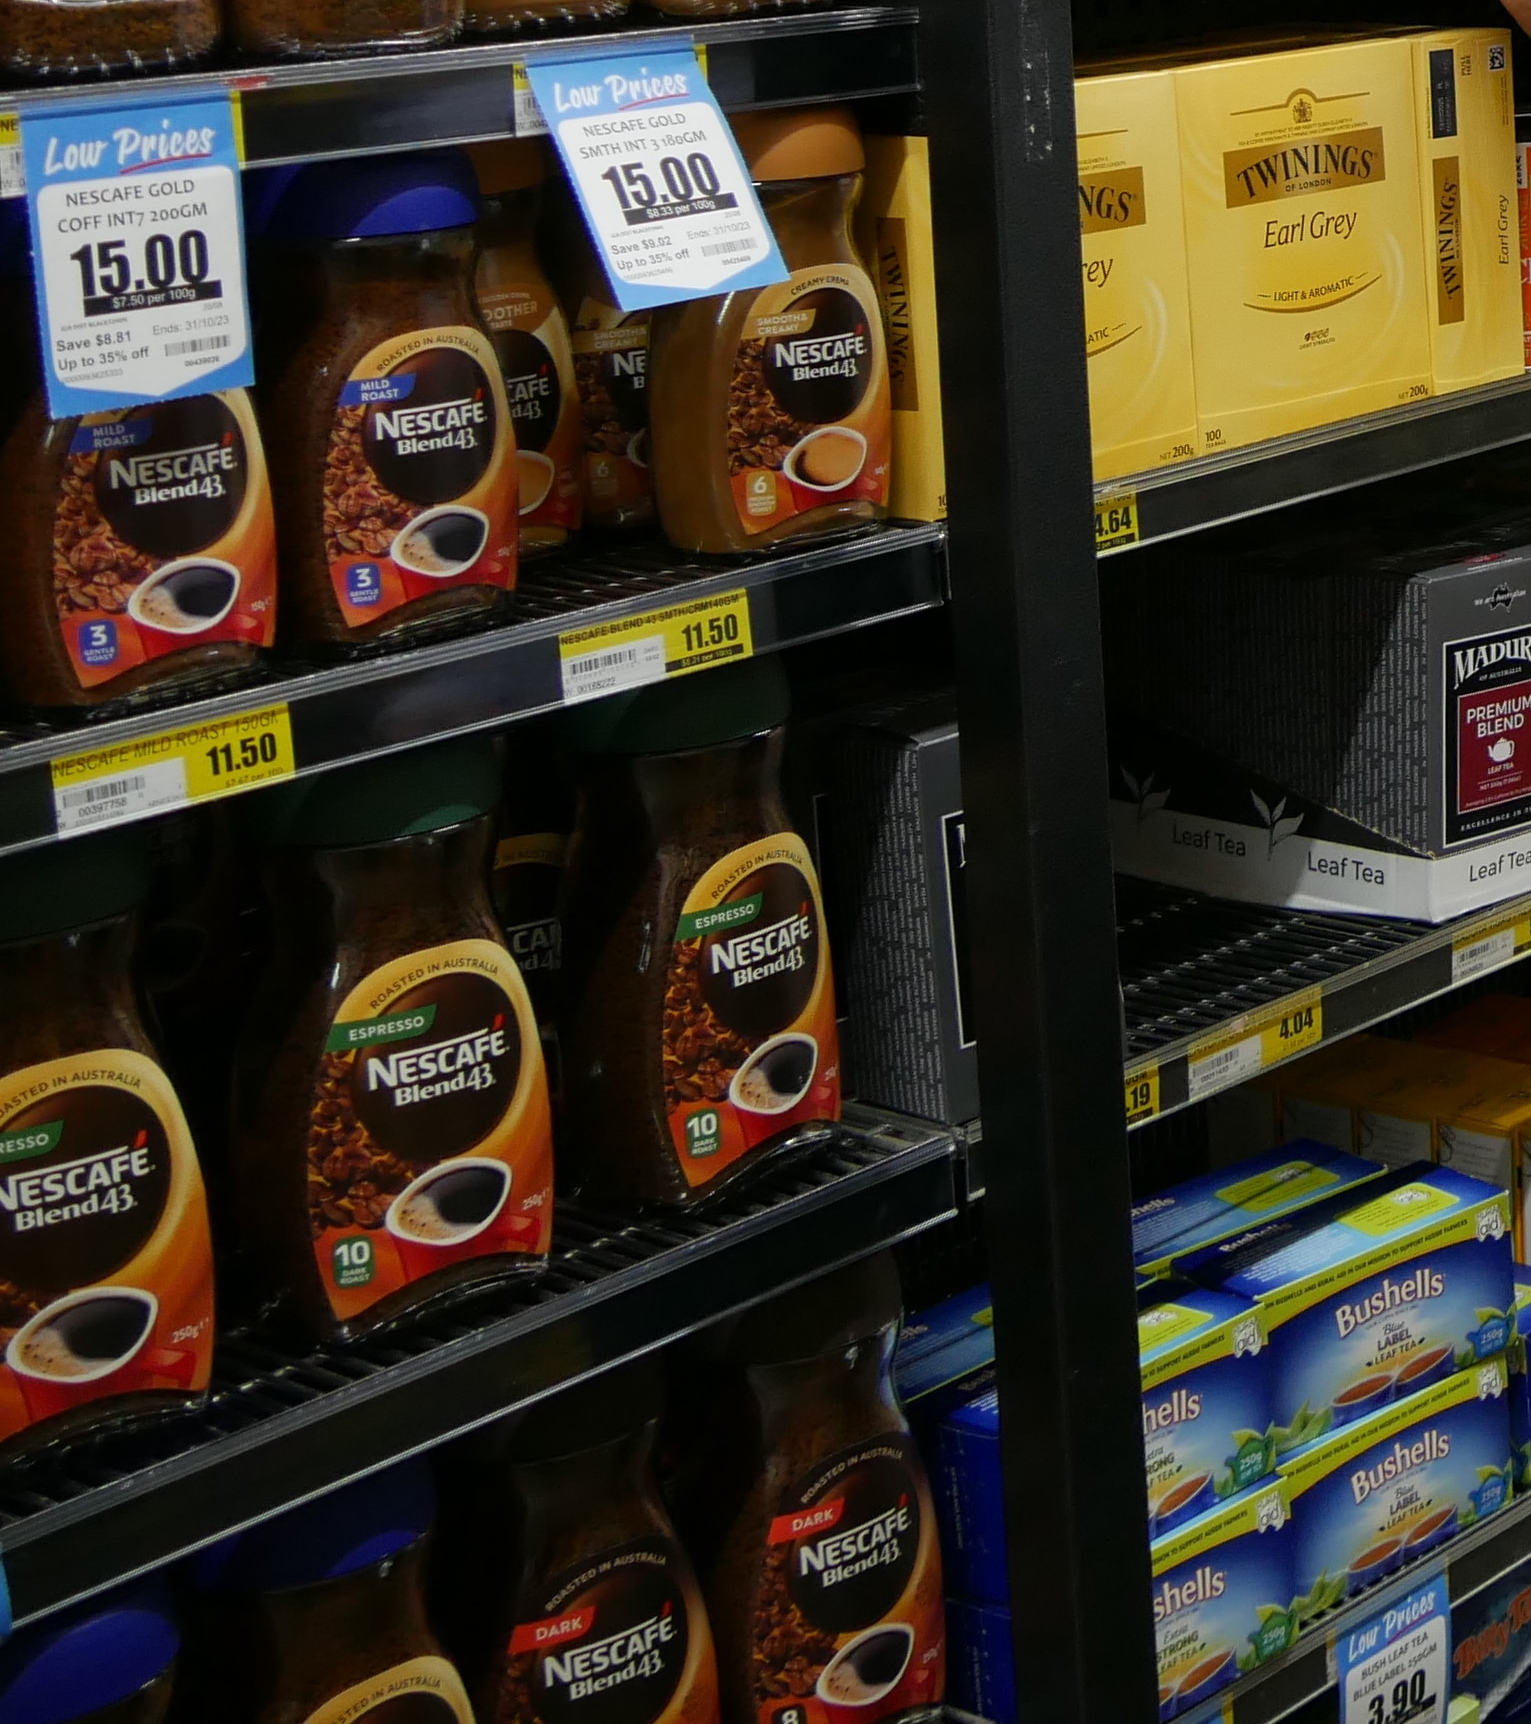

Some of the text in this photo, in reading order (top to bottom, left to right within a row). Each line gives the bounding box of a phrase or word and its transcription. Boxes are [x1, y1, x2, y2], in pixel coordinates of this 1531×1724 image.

[43, 119, 216, 178] Low Prices
[1237, 143, 1376, 199] TWININGS
[65, 177, 196, 208] NESCAFE GOLD
[56, 201, 208, 235] COFF INT7 200GM
[1264, 210, 1358, 249] Earl Grey
[70, 230, 210, 298] 15.00
[56, 336, 91, 354] Save
[152, 321, 183, 337] Ends:
[56, 345, 151, 373] Up to 35% off
[681, 612, 739, 649] 11.50
[1476, 714, 1525, 739] BLEND
[1468, 855, 1504, 883] Leaf
[348, 1012, 427, 1042] ESPRESSO
[1335, 1268, 1445, 1338] Bushells
[791, 1504, 836, 1534] DARK
[1368, 1671, 1428, 1723] 3.90
